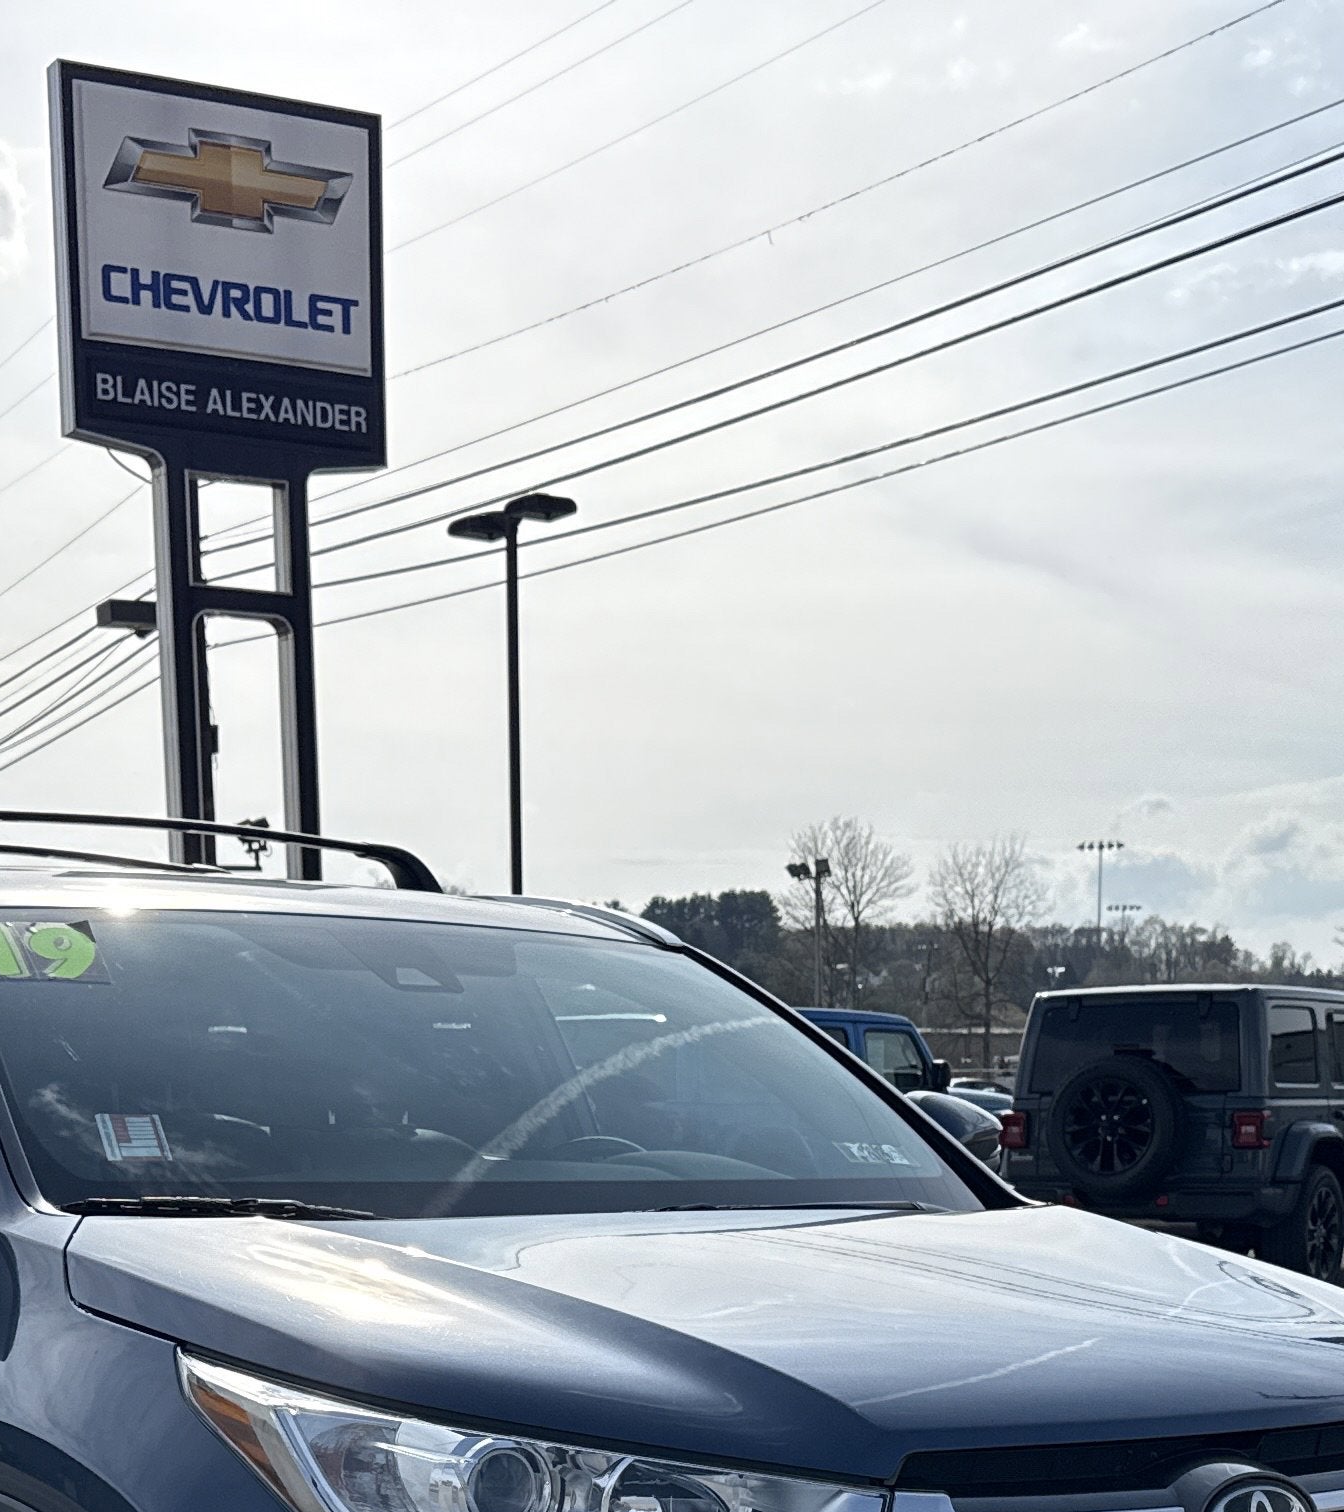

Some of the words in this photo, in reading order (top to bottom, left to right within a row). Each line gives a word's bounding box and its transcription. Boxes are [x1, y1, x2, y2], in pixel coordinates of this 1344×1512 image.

[101, 263, 359, 336] CHEVROLET
[95, 372, 197, 413] BLAISE
[206, 387, 368, 434] ALEXANDER
